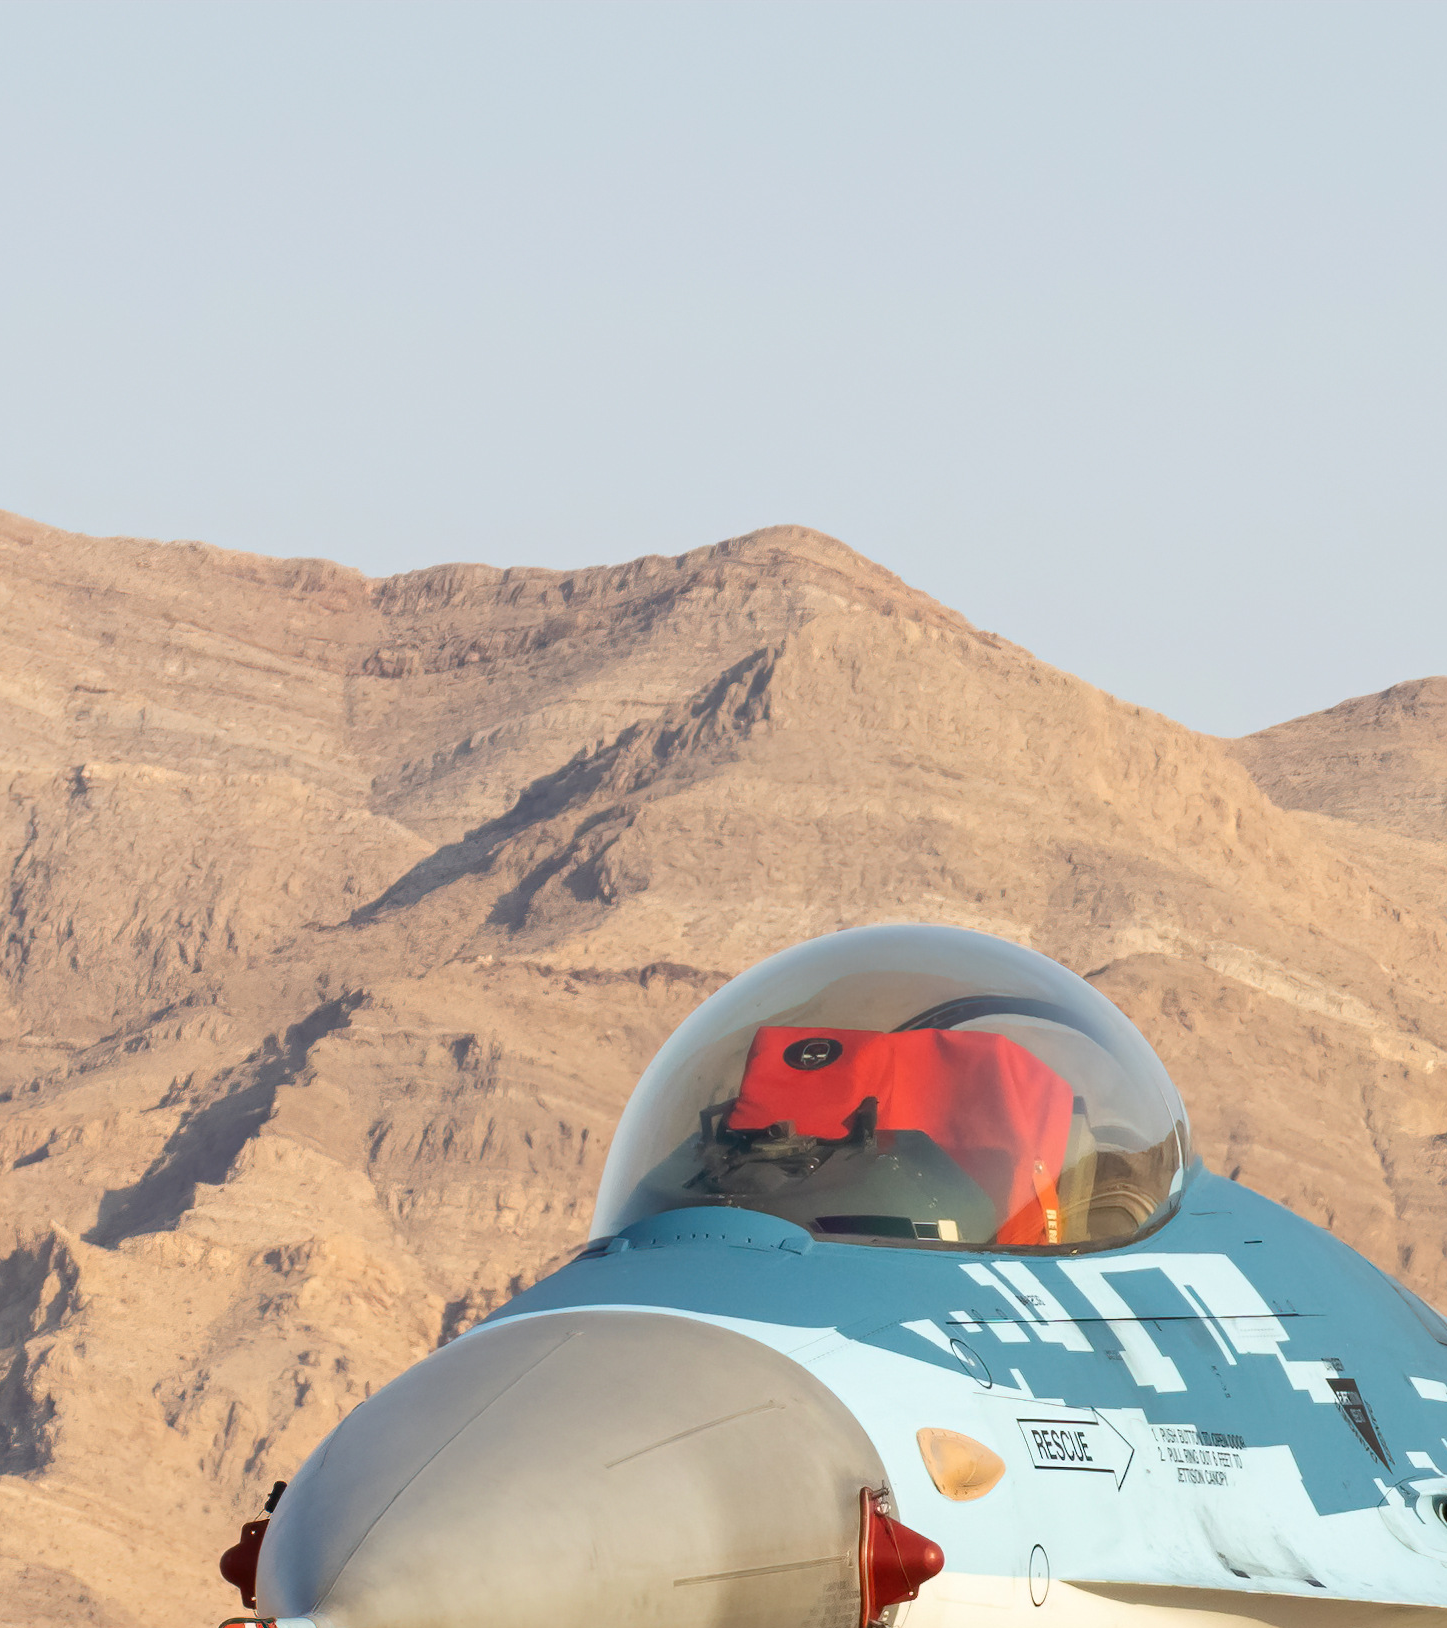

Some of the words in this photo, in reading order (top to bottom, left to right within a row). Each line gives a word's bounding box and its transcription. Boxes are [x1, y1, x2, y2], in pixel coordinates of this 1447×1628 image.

[1159, 1428, 1179, 1444] PUSH
[1031, 1429, 1094, 1462] RESCUE
[1167, 1447, 1184, 1463] PULL
